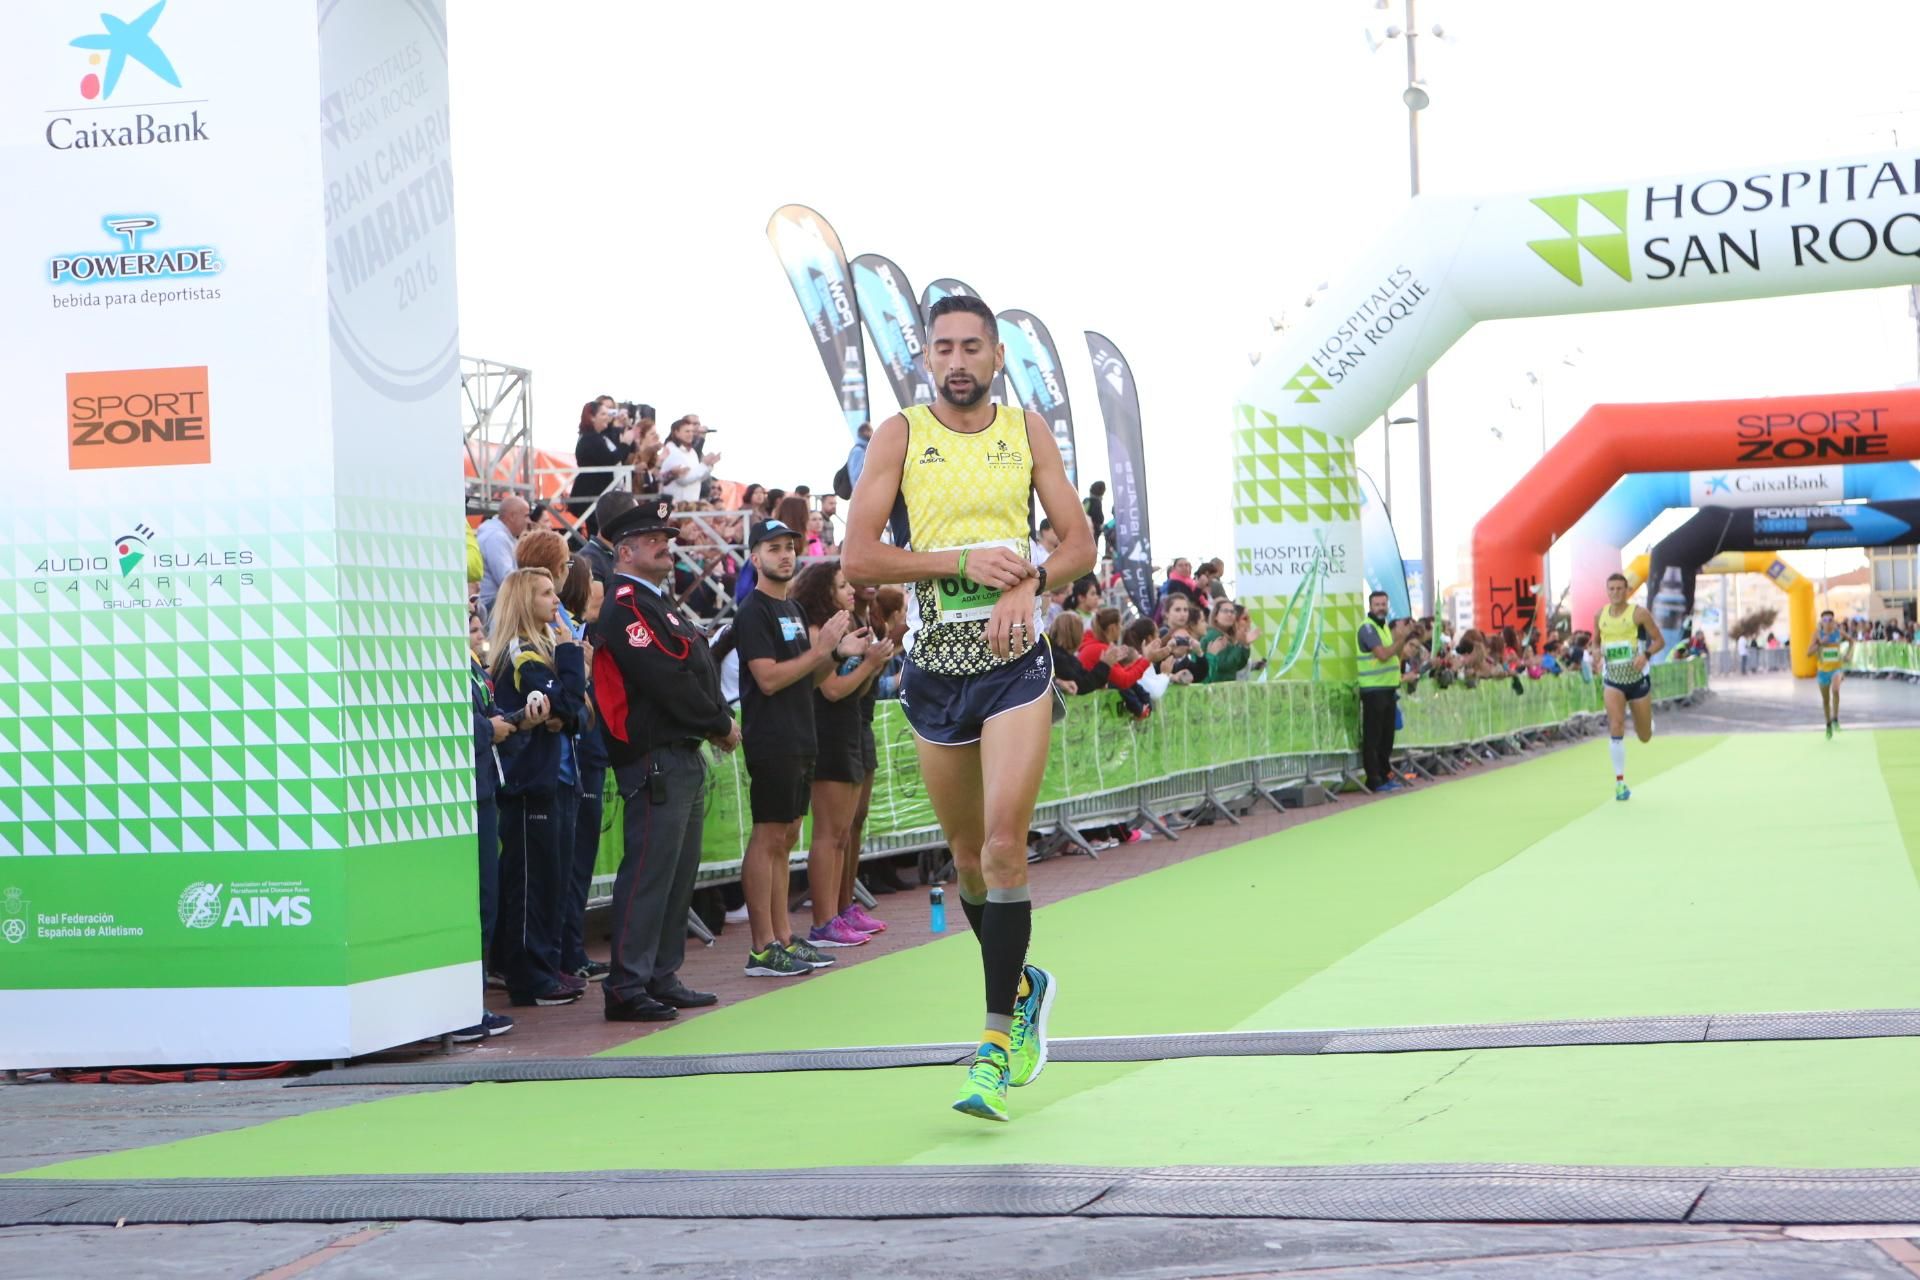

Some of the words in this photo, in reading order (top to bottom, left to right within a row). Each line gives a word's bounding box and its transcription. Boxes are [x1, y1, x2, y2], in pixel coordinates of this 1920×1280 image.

[344, 40, 424, 108] HOSPITALES
[349, 107, 379, 143] SAN
[383, 71, 430, 120] ROQUE
[45, 110, 210, 150] CaixaBank
[1645, 158, 1920, 221] HOSPITA
[52, 250, 214, 279] POWERADE
[1643, 229, 1760, 280] SAN
[394, 251, 439, 312] 2016
[53, 292, 100, 308] bebida
[105, 292, 137, 310] para
[141, 286, 221, 306] deportistas
[1312, 264, 1412, 368] HOSPITALES
[1327, 343, 1367, 384] SAN
[1364, 280, 1430, 345] ROQUE
[72, 391, 205, 422] SPORT
[72, 416, 205, 446] ZONE
[1737, 408, 1889, 439] SPORT
[987, 451, 1022, 462] HPS
[1737, 434, 1889, 462] ZONE
[1735, 473, 1829, 493] CaixaBank
[1754, 505, 1857, 519] POWERADE
[35, 556, 108, 572] AUDIO
[1254, 544, 1346, 560] HOSPITALES
[34, 572, 254, 594] CANARIAS
[1254, 562, 1283, 576] SAN
[1291, 560, 1347, 578] ROQUE
[103, 599, 151, 609] GRUPO
[155, 597, 183, 608] AVC
[961, 594, 981, 604] ADAY
[982, 591, 1001, 600] LOPE
[38, 913, 59, 925] Real
[61, 912, 114, 924] Federación
[222, 895, 312, 927] AIMS
[38, 926, 82, 939] Española
[84, 926, 96, 937] de
[98, 925, 144, 936] Atletismo
